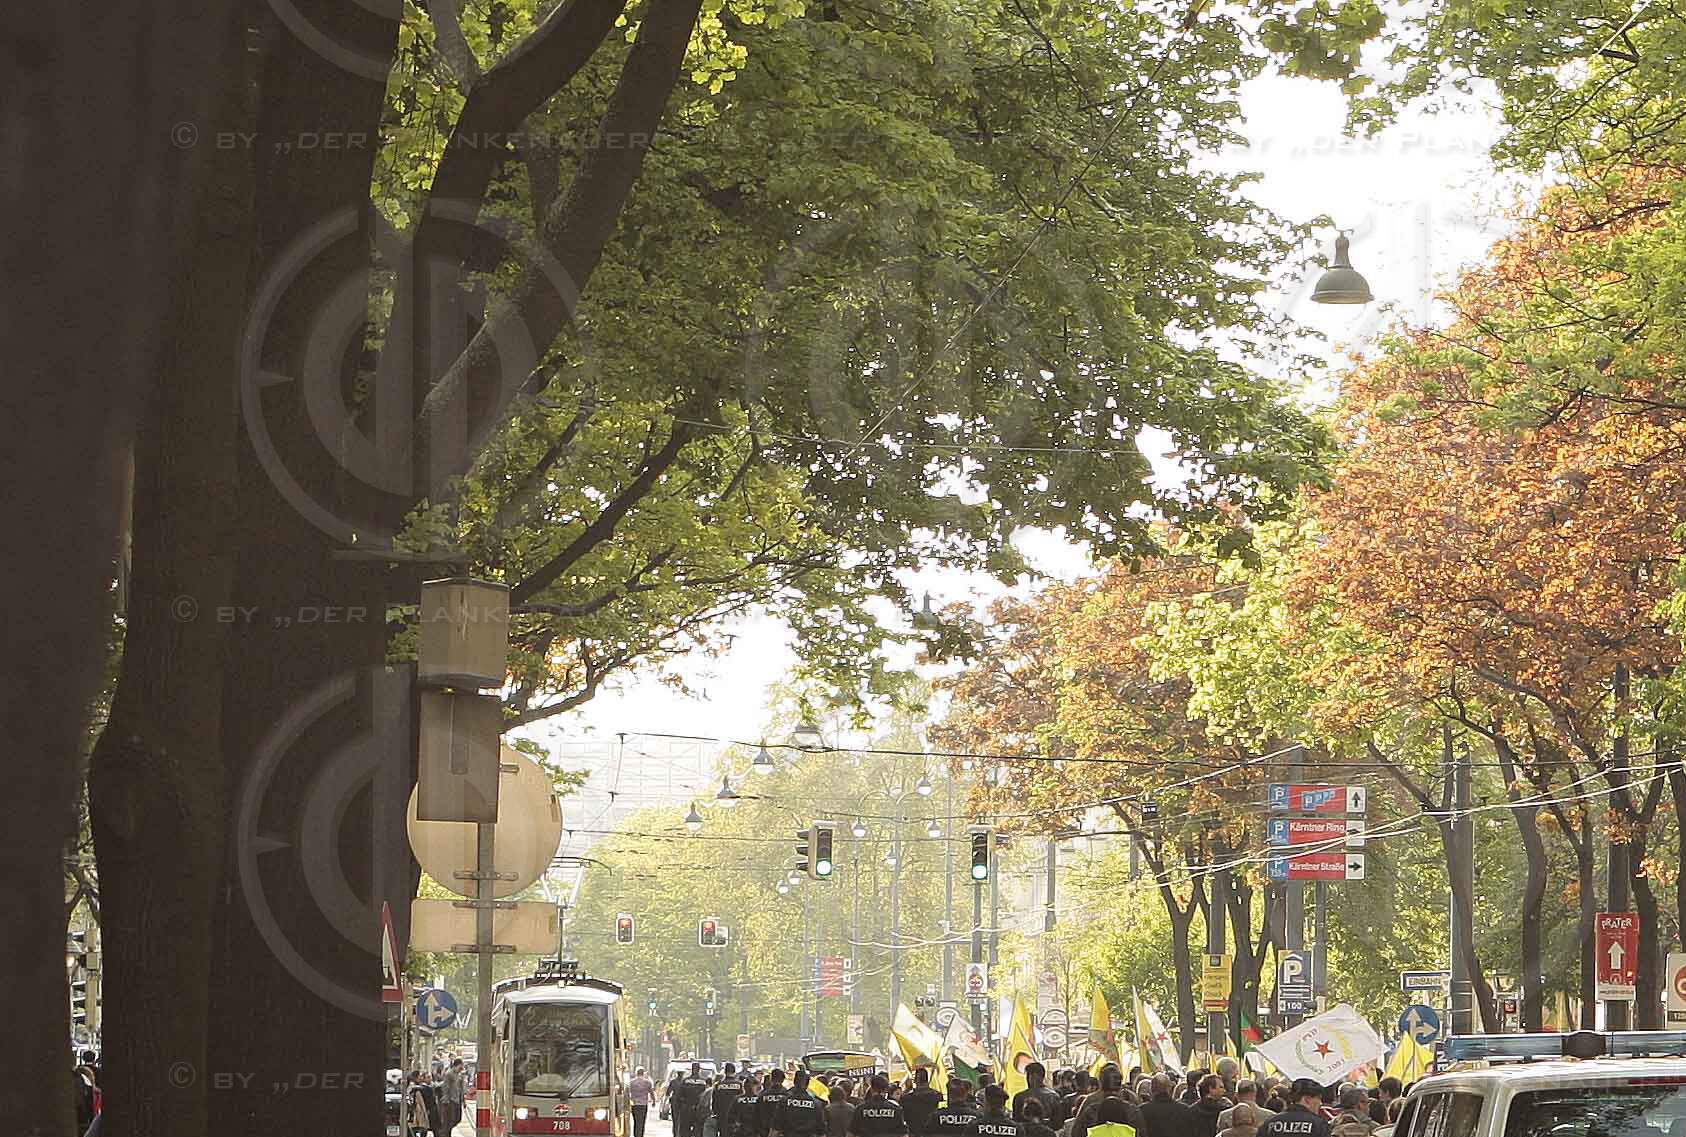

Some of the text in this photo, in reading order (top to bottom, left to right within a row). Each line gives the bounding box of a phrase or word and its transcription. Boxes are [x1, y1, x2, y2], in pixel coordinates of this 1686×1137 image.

[1326, 822, 1345, 833] Ring
[1601, 918, 1633, 930] PRATER
[1283, 960, 1302, 984] P
[863, 1109, 895, 1118] POLIZEI
[552, 1120, 570, 1130] 708
[978, 1124, 1017, 1136] POLIZEI
[1267, 1121, 1313, 1136] POLIZEI
